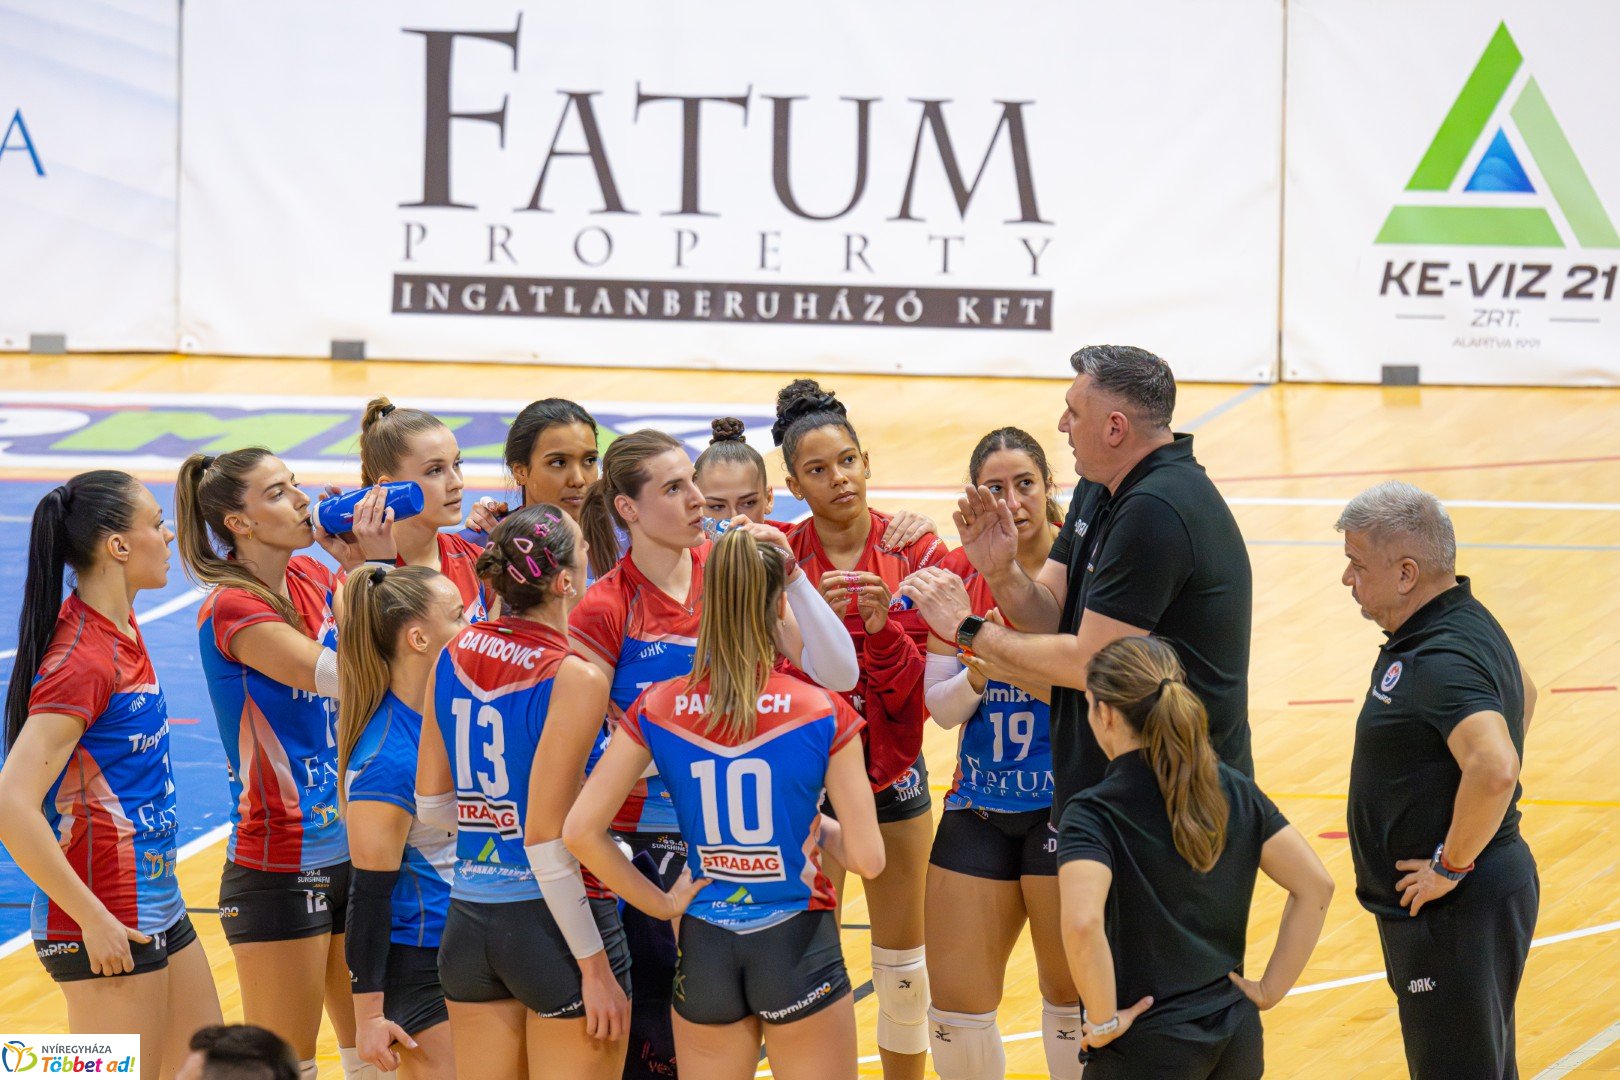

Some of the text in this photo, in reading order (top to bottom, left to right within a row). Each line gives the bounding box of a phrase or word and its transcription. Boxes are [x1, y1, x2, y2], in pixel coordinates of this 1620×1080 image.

[398, 12, 1055, 225] FATUM
[403, 222, 1052, 276] PROPERTY
[401, 281, 1045, 326] INGATLANBERUHÁZÓ KFT
[1379, 261, 1618, 301] KE-VIZ 21
[458, 631, 546, 670] DAVIDOVIĆ
[451, 698, 510, 798] 13
[989, 711, 1034, 763] 19
[690, 758, 774, 845] 10
[703, 855, 779, 871] STRABAG
[303, 889, 328, 914] 12
